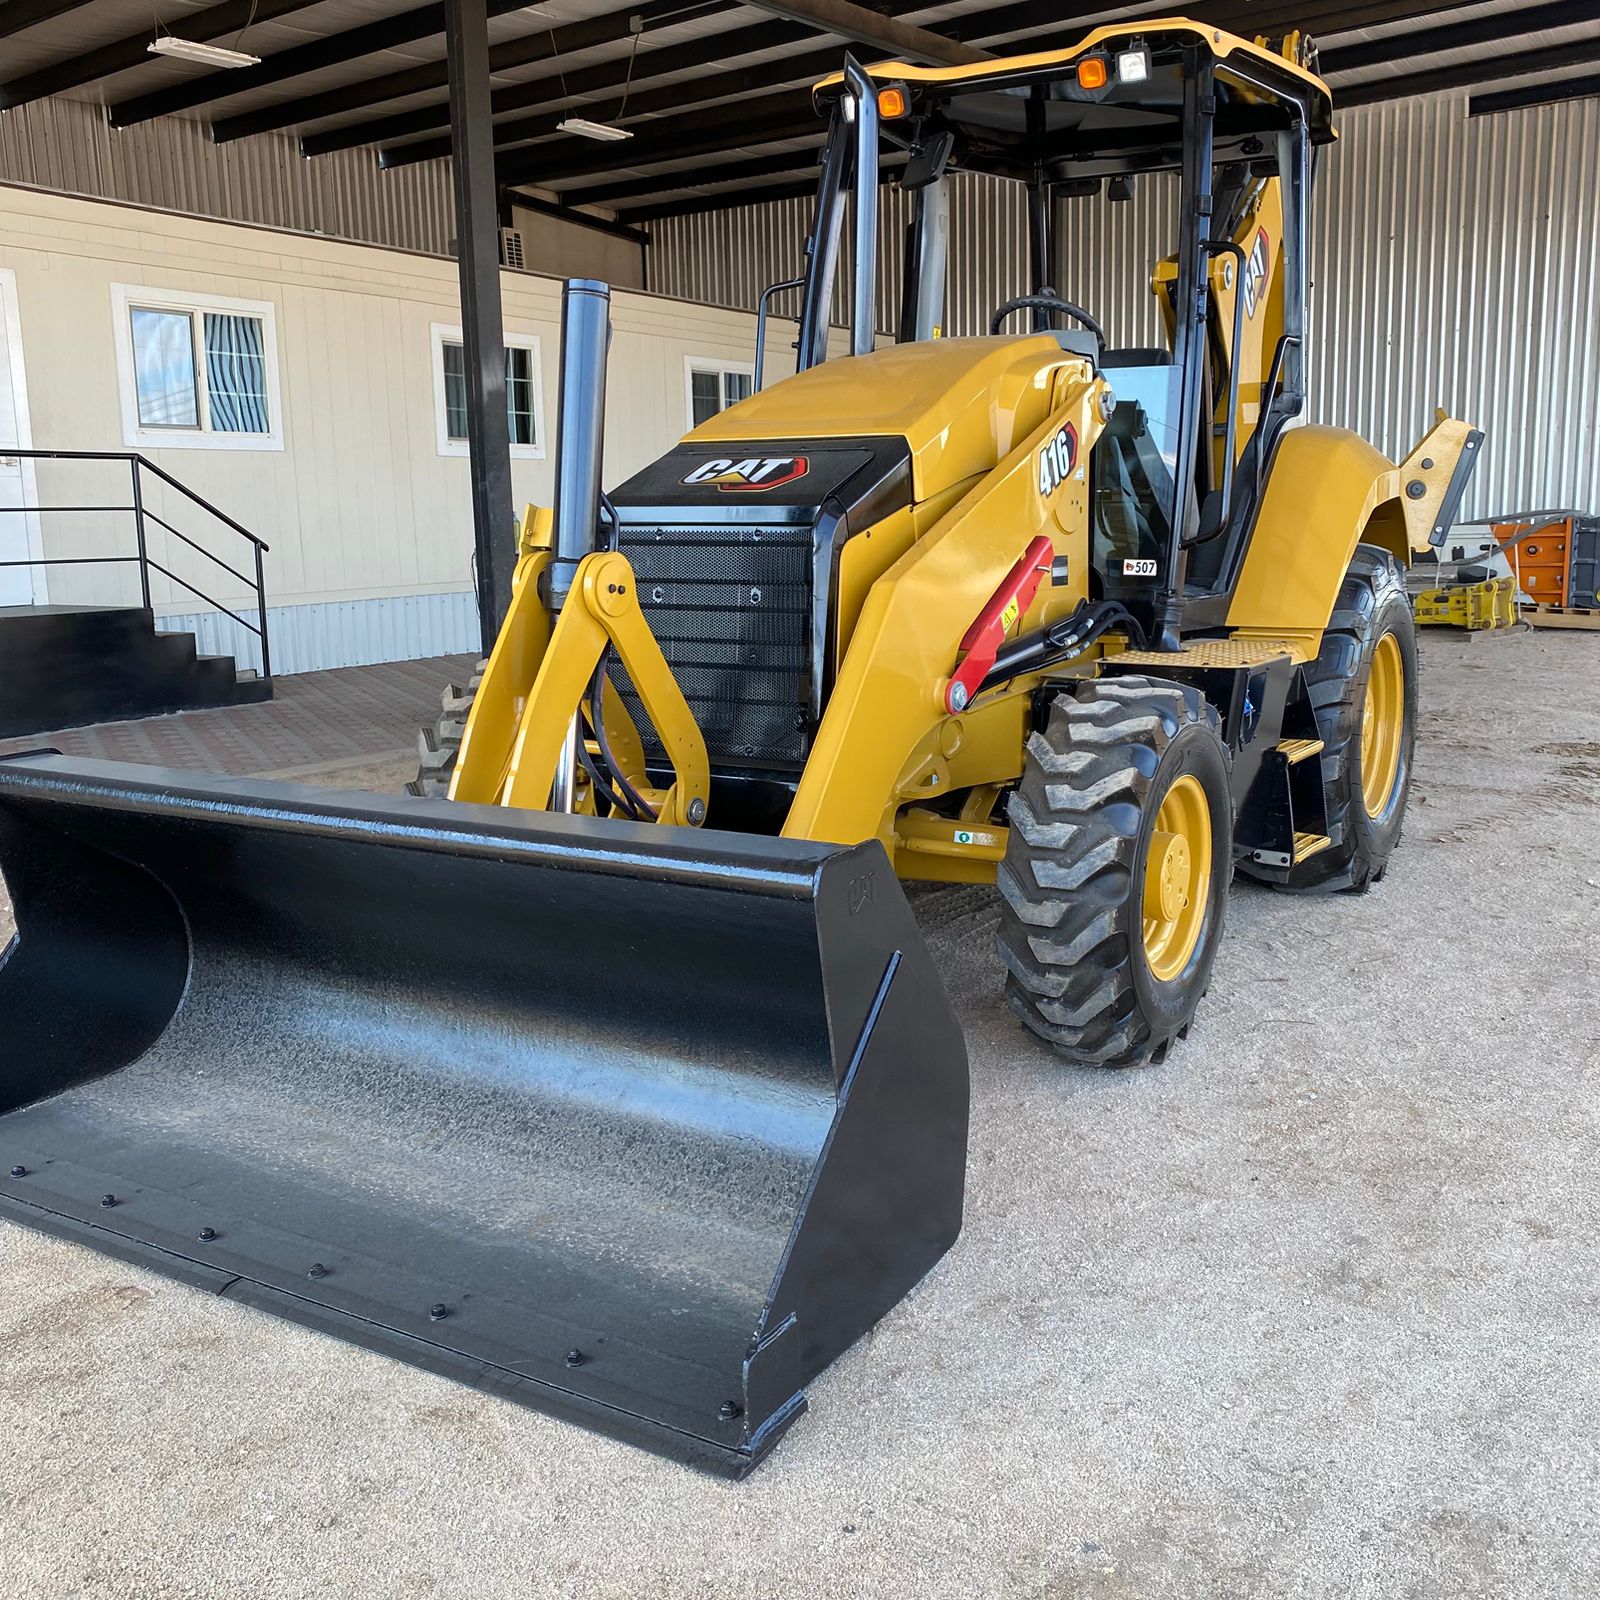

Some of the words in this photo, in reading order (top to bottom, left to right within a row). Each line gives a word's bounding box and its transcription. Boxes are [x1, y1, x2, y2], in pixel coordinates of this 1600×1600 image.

[1244, 232, 1265, 319] CAT
[683, 457, 794, 483] CAT
[1040, 429, 1071, 496] 416
[1135, 561, 1155, 574] 507
